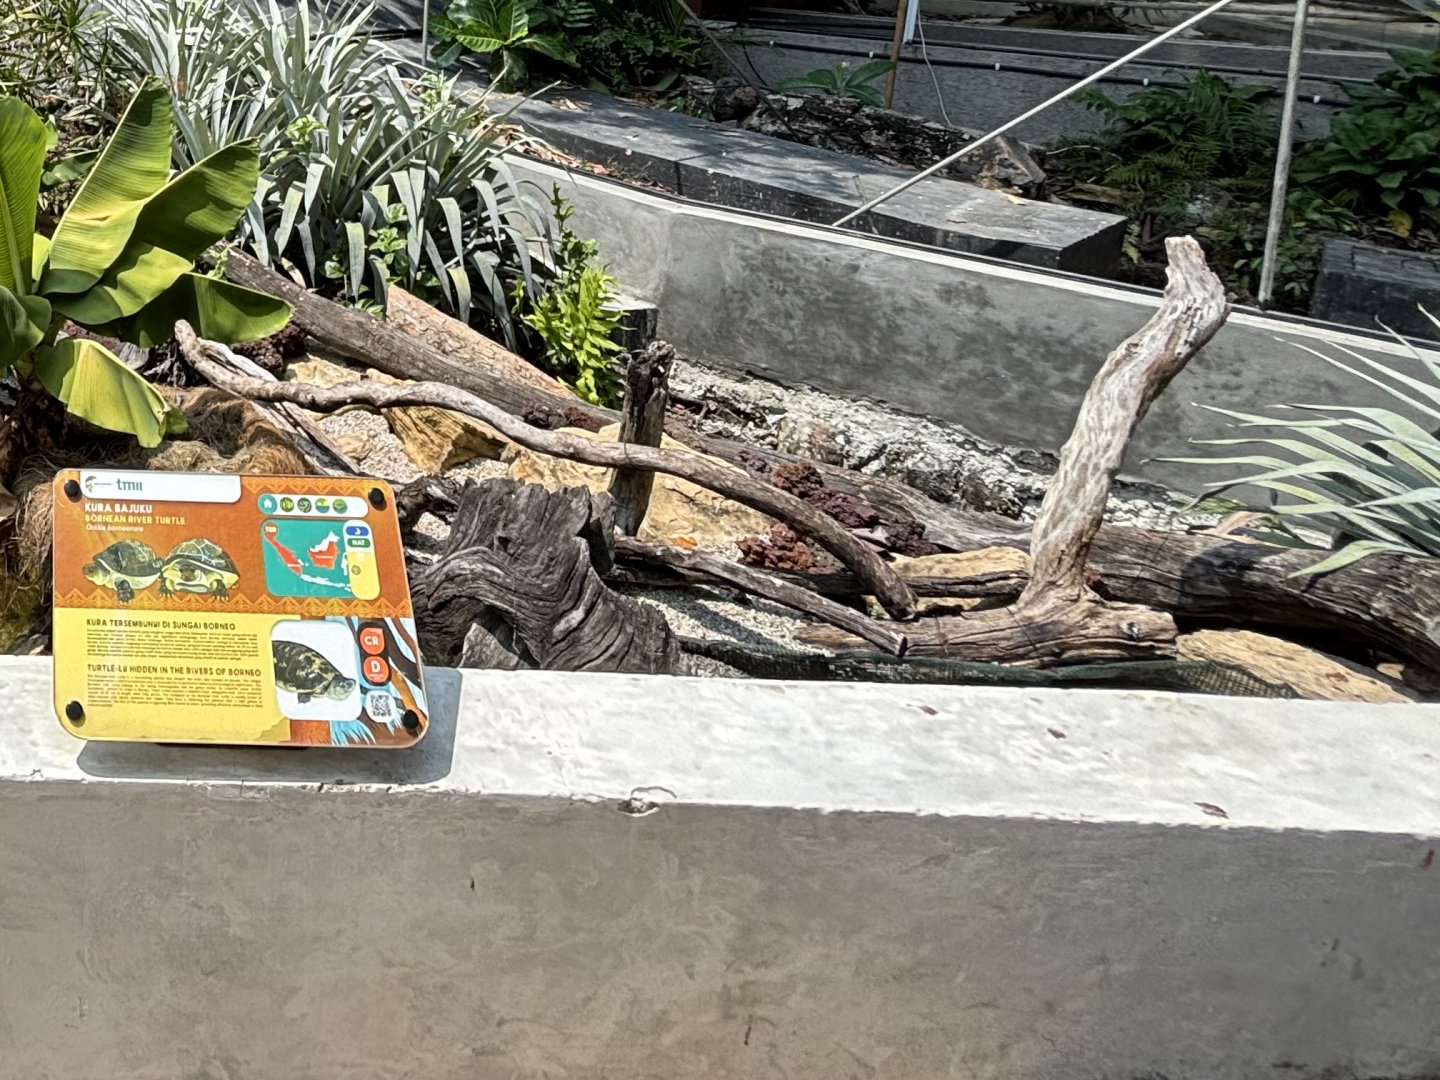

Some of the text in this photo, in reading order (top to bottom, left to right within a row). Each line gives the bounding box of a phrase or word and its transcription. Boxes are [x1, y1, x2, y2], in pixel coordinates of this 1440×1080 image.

[84, 503, 153, 514] KURA BAJUKU
[84, 514, 186, 526] BORNEAN RIVER TURTLE
[86, 618, 108, 627] KURA
[162, 620, 171, 629] DI
[172, 621, 202, 630] SUNGAI
[203, 622, 236, 631] BORNEO
[364, 635, 379, 646] CR
[129, 665, 158, 674] HIDDEN
[160, 666, 169, 674] IN
[170, 666, 184, 675] THE
[186, 667, 214, 676] RIVERS
[215, 668, 227, 676] OF
[228, 668, 262, 677] BORNEO
[370, 659, 381, 673] D
